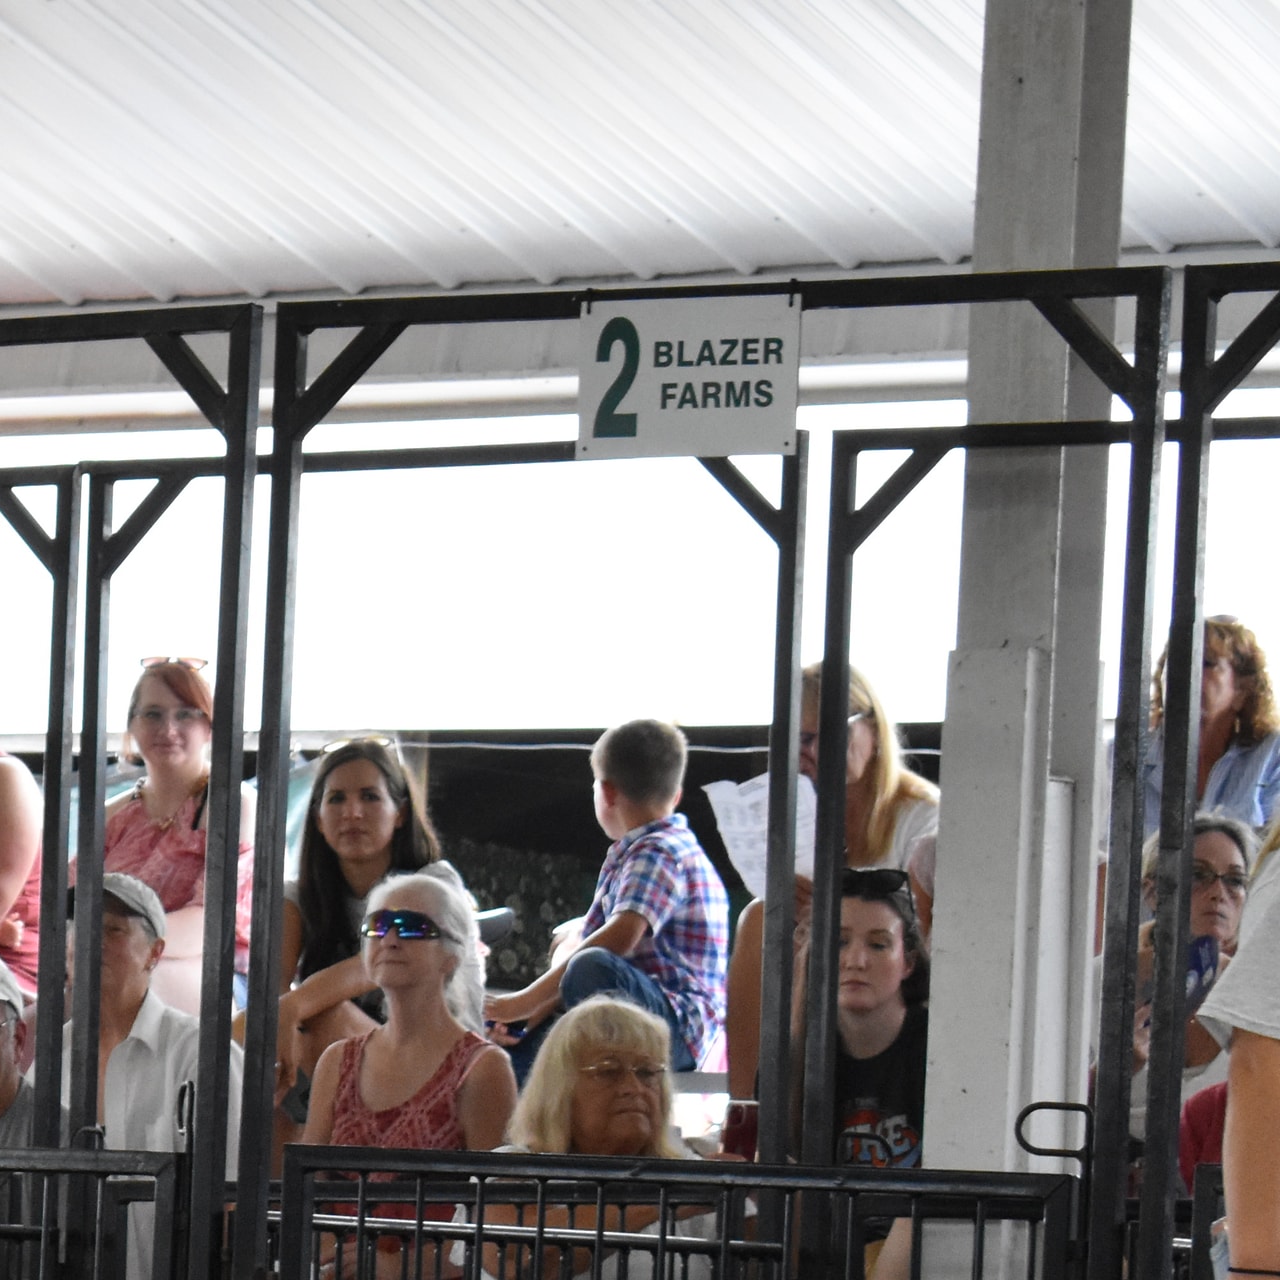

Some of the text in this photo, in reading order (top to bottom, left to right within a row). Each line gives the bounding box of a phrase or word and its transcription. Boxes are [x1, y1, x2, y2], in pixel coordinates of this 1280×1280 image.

[653, 337, 784, 368] BLAZER
[593, 316, 640, 438] 2
[660, 379, 774, 410] FARMS
